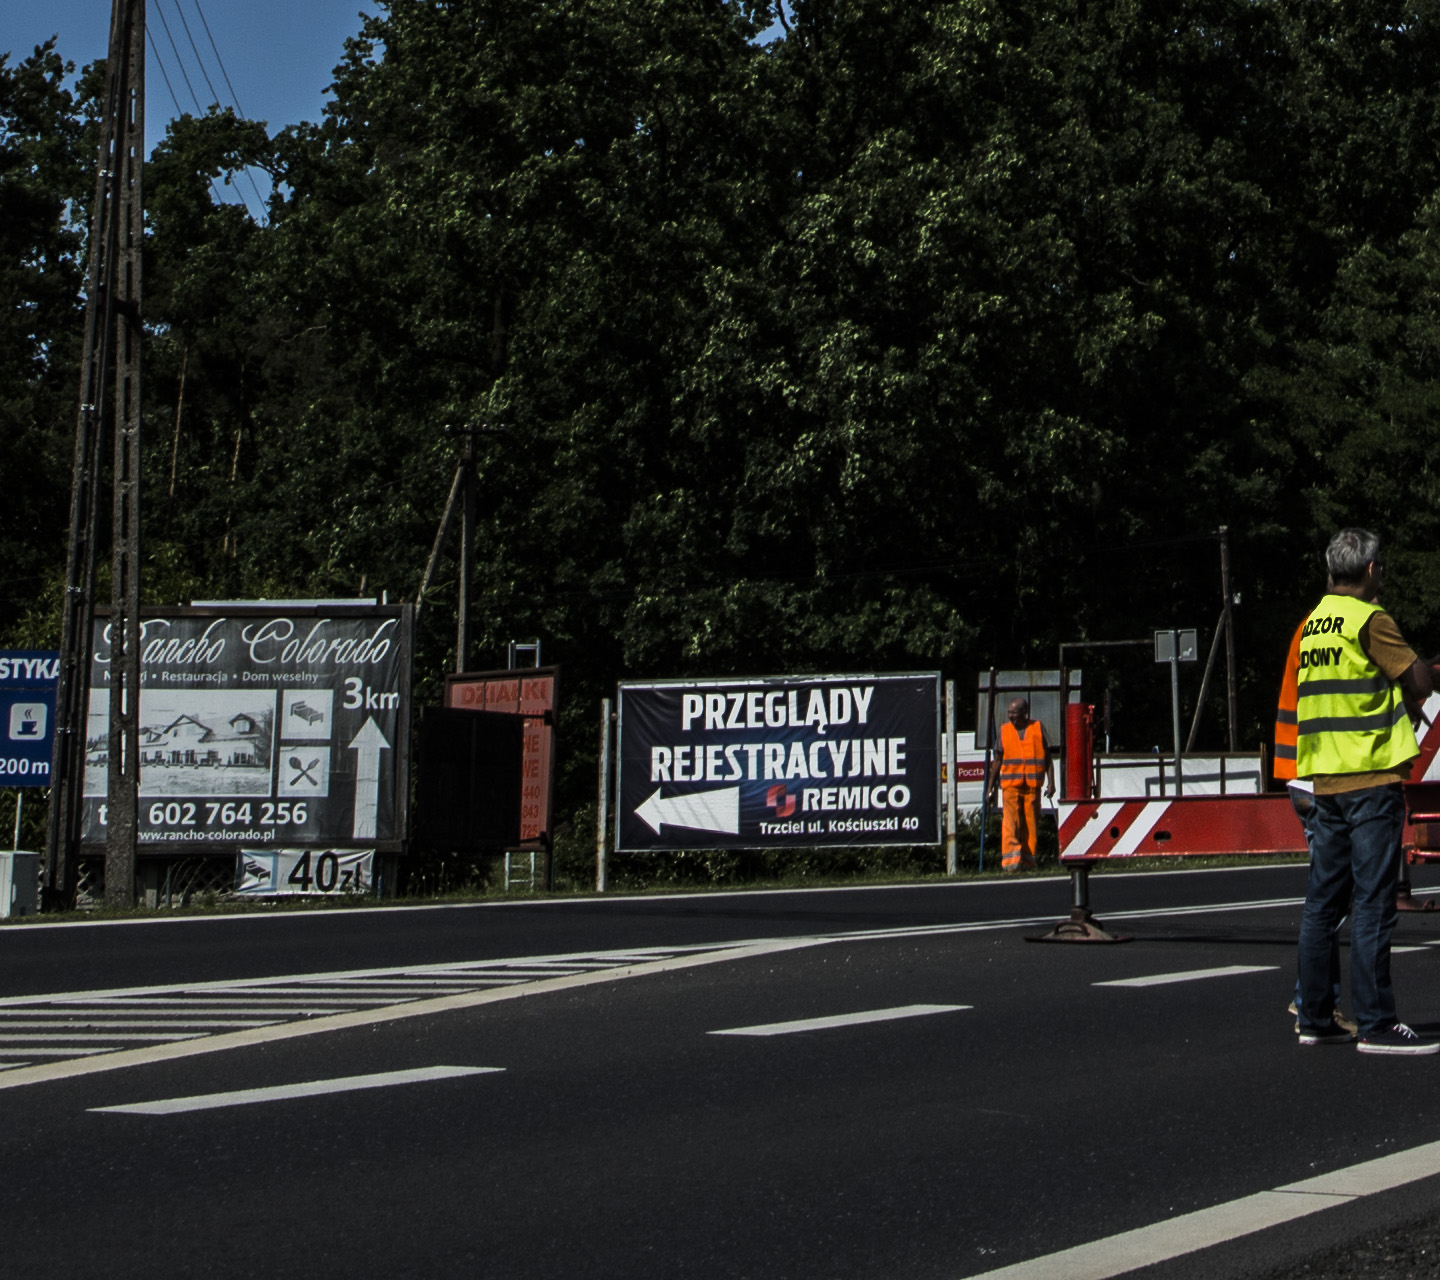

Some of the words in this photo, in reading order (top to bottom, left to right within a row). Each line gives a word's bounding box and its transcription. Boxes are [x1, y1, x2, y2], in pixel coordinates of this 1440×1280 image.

[241, 618, 399, 663] Colorado
[161, 671, 228, 684] Restauracja
[242, 671, 269, 681] Dom
[272, 671, 319, 684] weselny
[682, 686, 875, 734] PRZEGLĄDY
[650, 738, 906, 782] REJESTRACYJNE
[958, 767, 985, 778] Poczta
[802, 785, 911, 812] REMICO
[149, 802, 197, 825] 602
[205, 802, 253, 825] 764
[260, 802, 308, 825] 256
[137, 828, 275, 843] ww.rancho-colorado.pl
[759, 820, 805, 835] Trzciel
[808, 820, 825, 834] ul.
[828, 817, 898, 833] Kościuszki
[902, 817, 919, 831] 40
